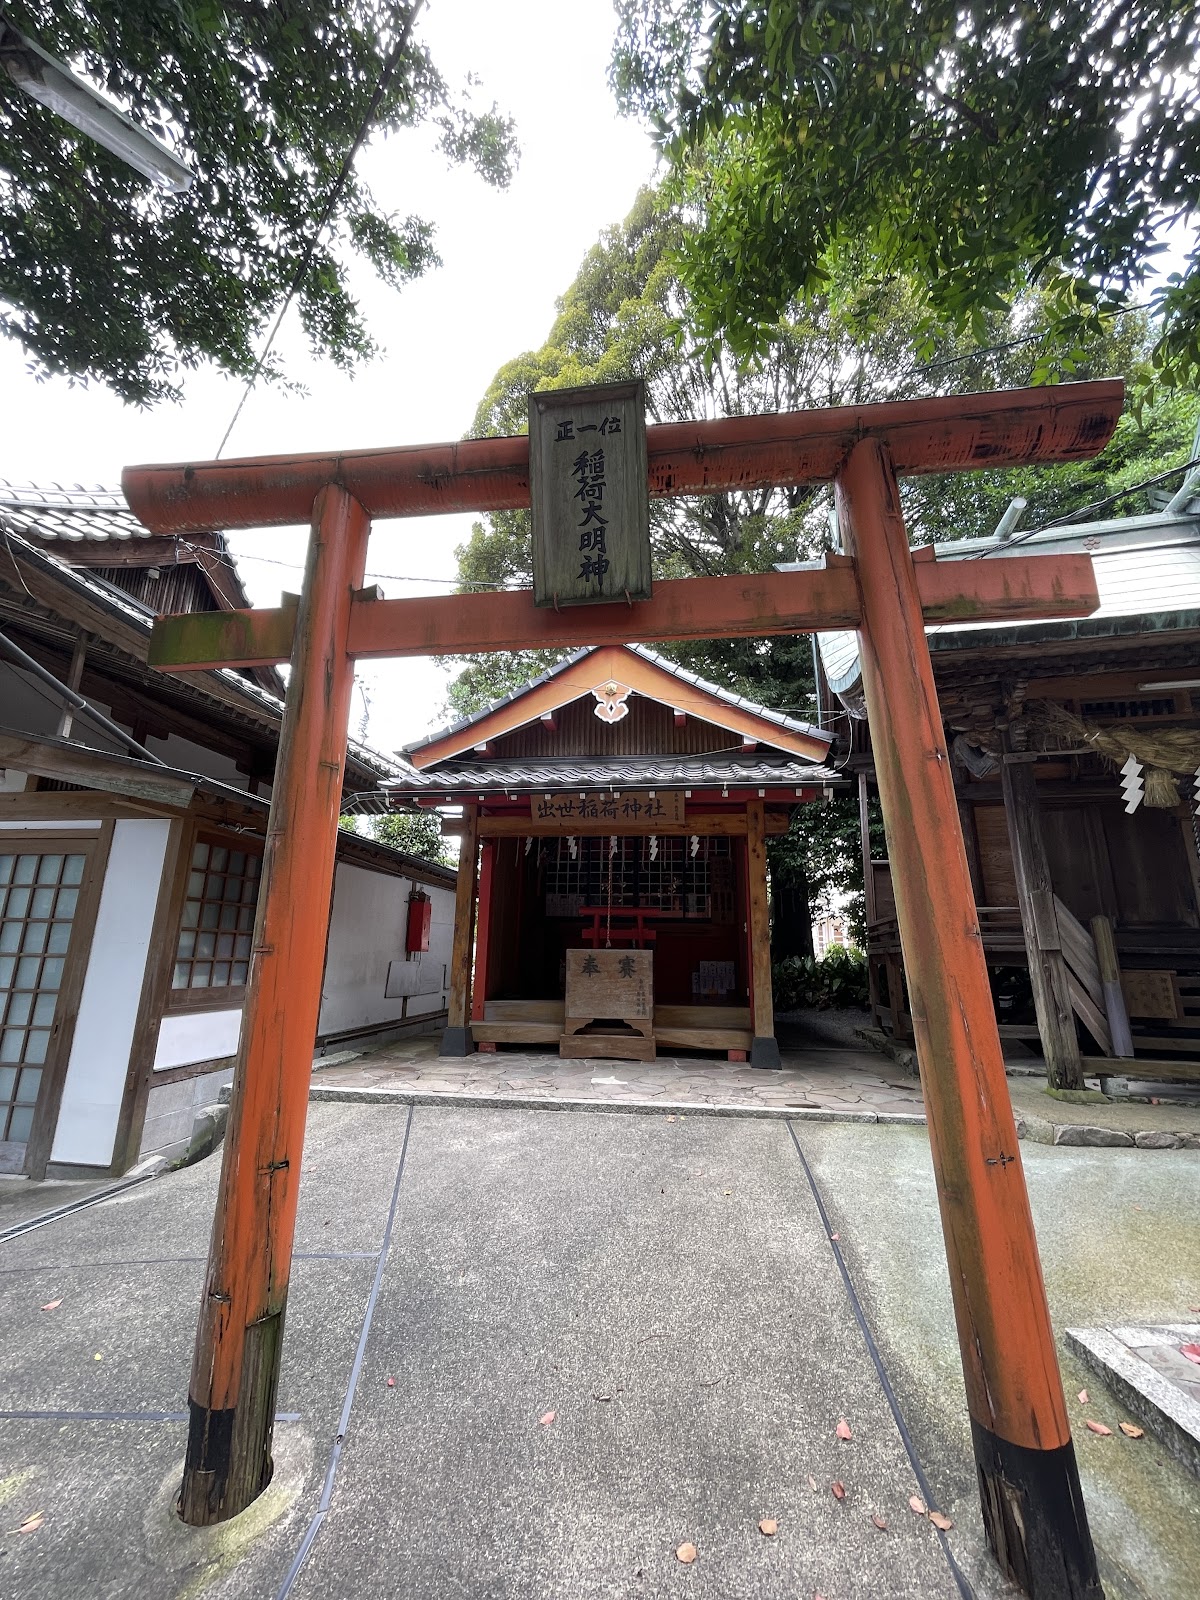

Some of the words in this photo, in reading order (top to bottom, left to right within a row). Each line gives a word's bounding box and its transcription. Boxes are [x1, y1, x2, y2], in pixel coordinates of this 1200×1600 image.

[554, 416, 622, 442] 正一位
[571, 448, 610, 586] 稲荷大明神
[537, 798, 667, 820] 出世稲荷神社
